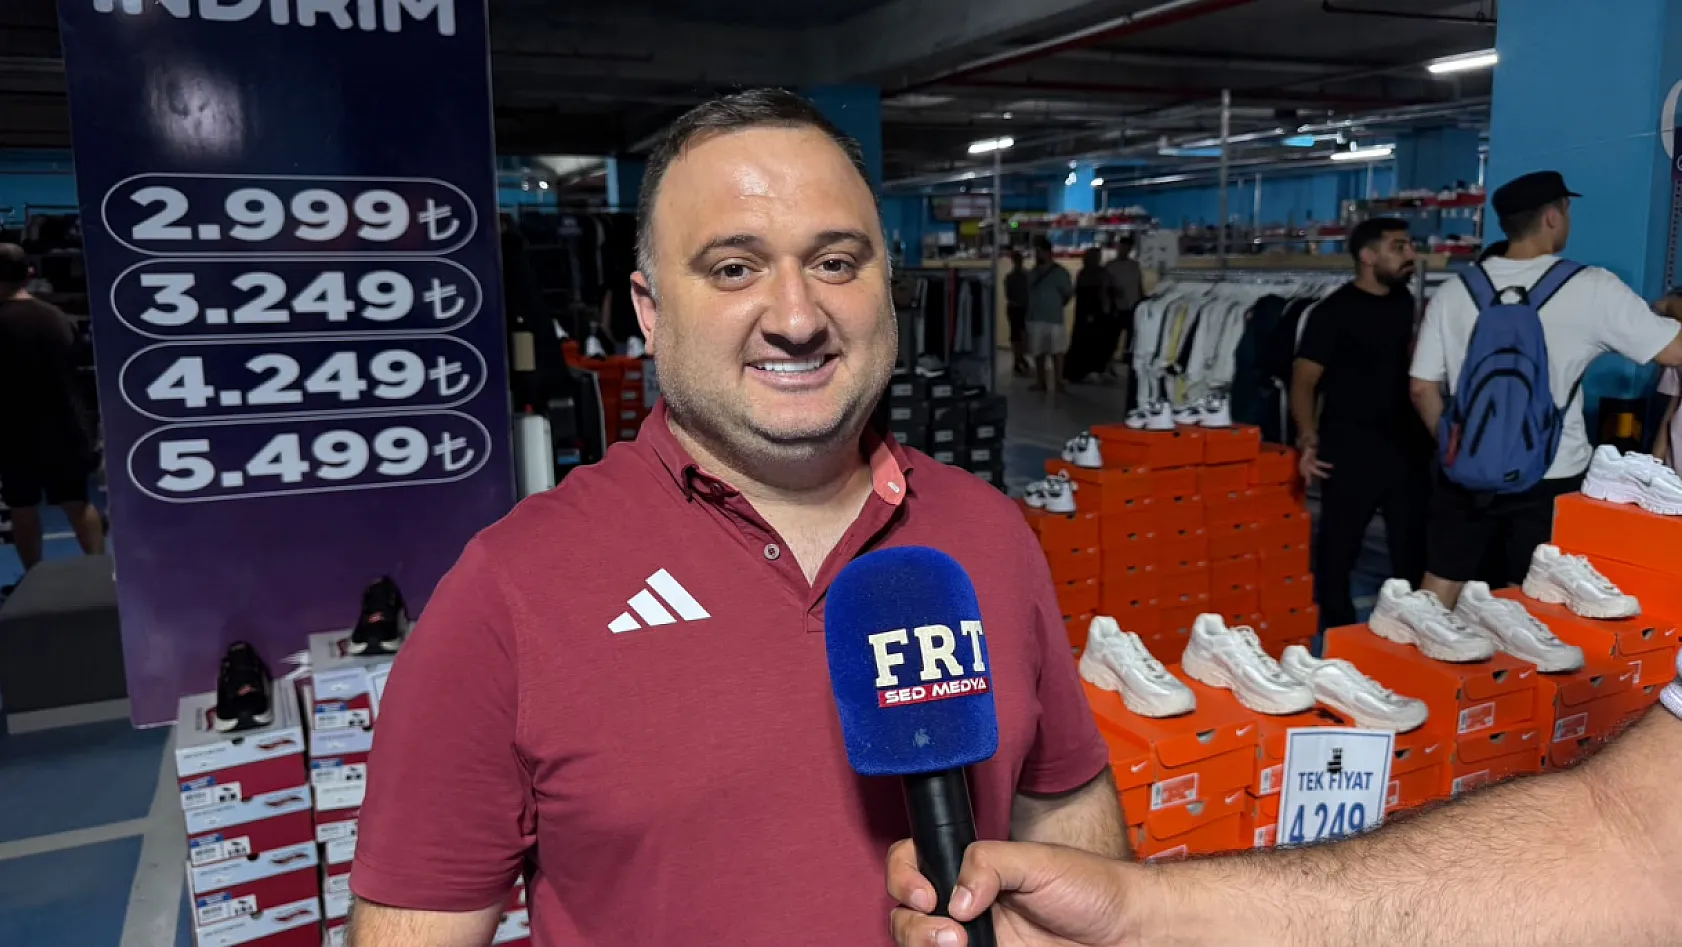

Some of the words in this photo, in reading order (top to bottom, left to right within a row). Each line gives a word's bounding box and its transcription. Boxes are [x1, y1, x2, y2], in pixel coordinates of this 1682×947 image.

[868, 620, 986, 687] FRT
[884, 685, 927, 704] SED
[931, 677, 987, 697] MEDYA
[1298, 771, 1325, 791] TEK
